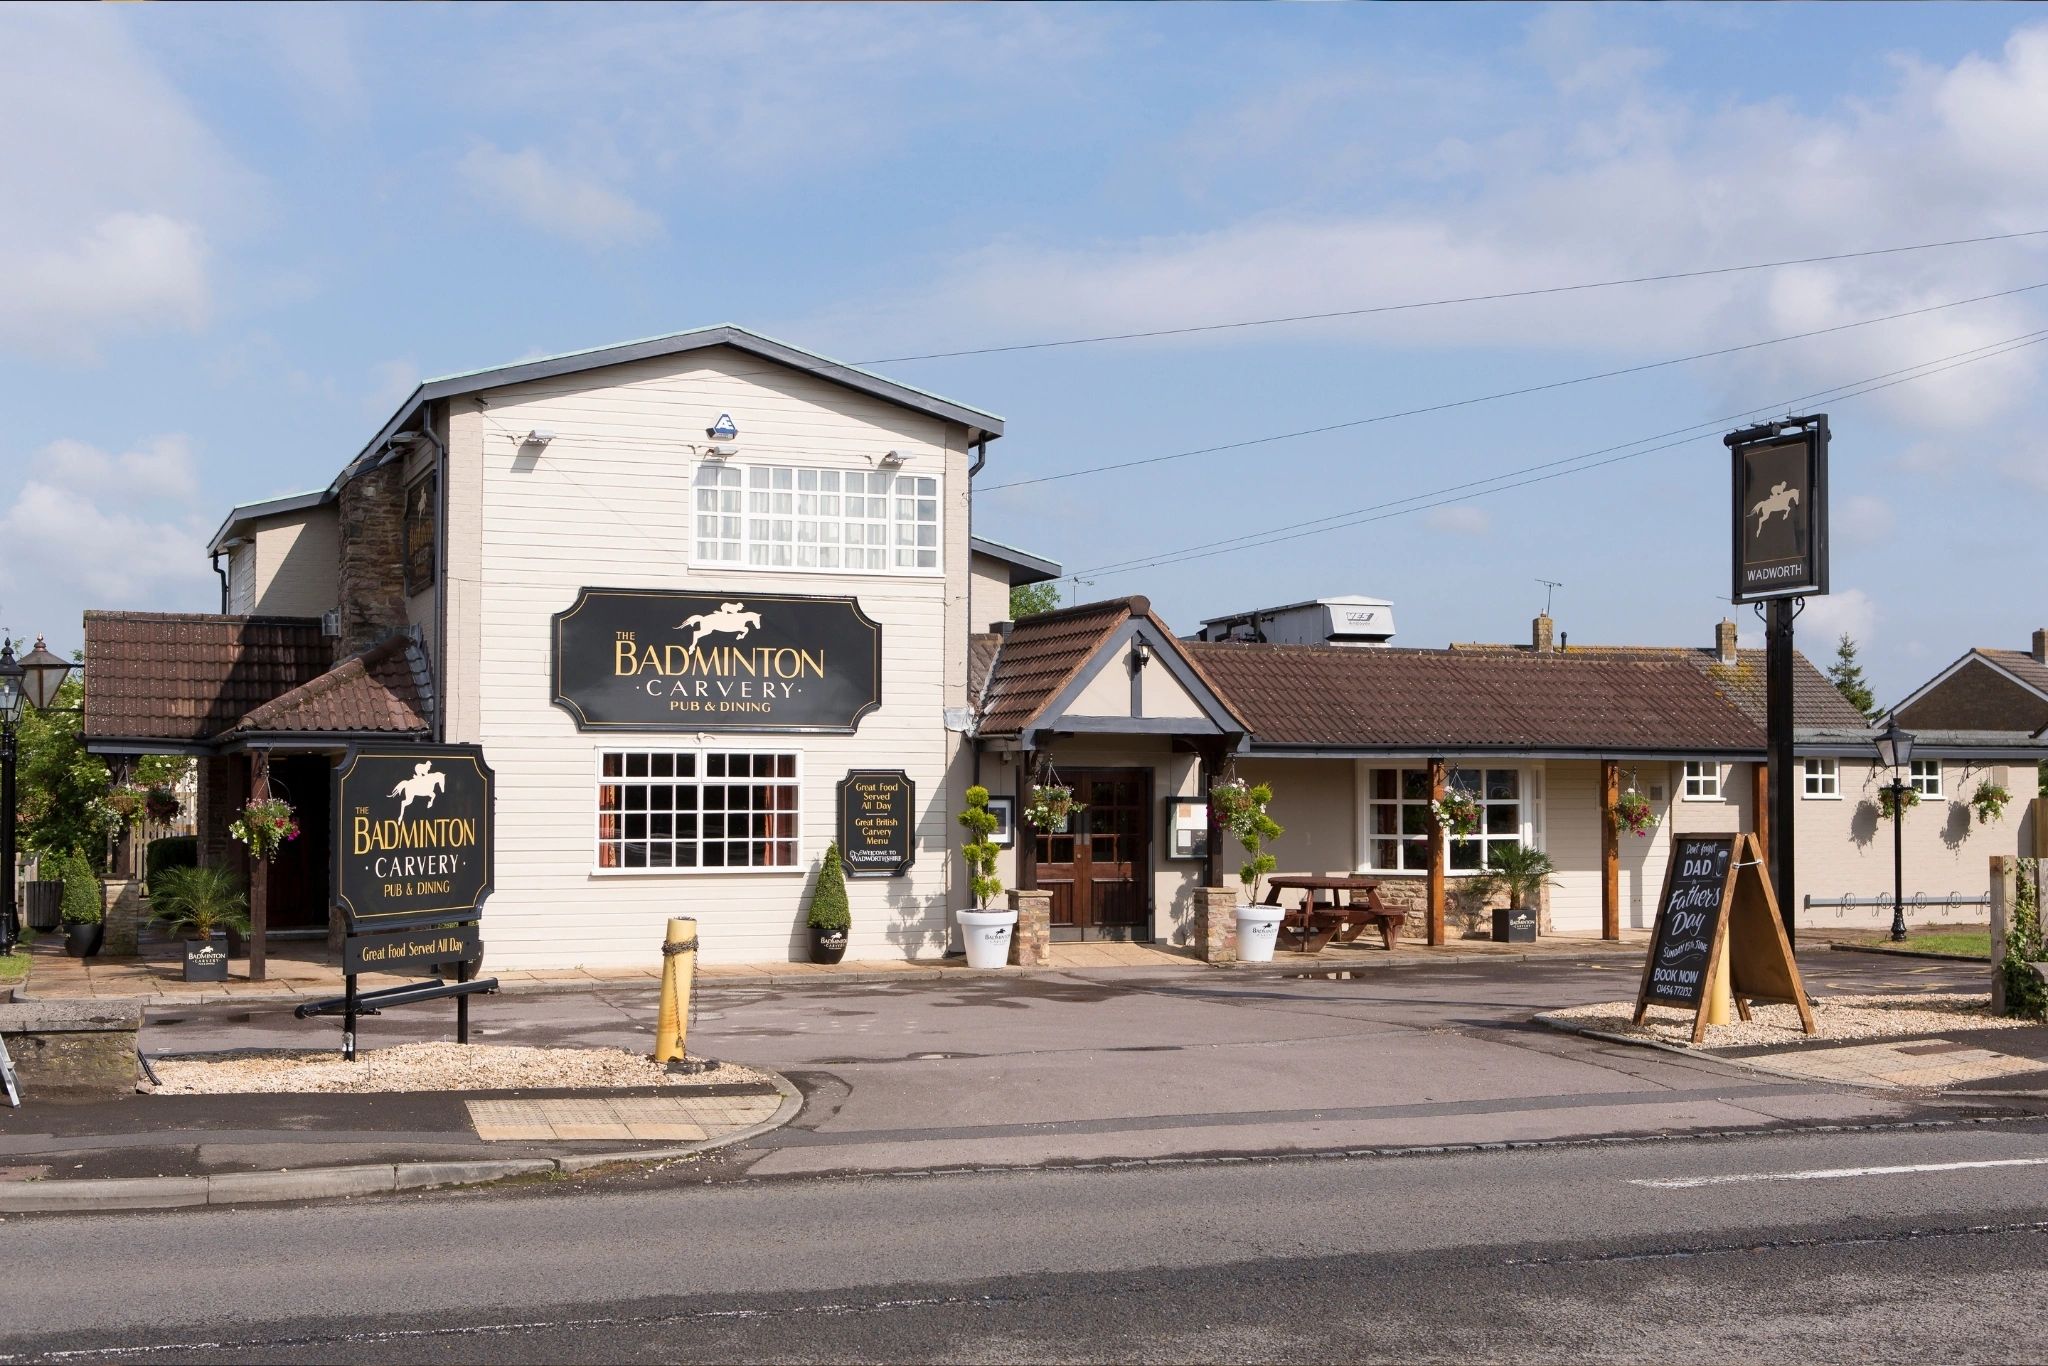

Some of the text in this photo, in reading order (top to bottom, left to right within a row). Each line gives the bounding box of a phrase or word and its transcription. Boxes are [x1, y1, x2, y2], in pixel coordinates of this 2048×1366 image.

[1747, 563, 1802, 581] WADWORTH
[616, 631, 635, 641] THE
[614, 640, 824, 679] BADMINTON
[646, 679, 795, 699] CARVERY
[670, 701, 771, 713] PUB & DINING
[855, 782, 898, 791] Great Food
[863, 792, 890, 800] Served
[355, 806, 369, 815] THE
[861, 802, 892, 811] All Day
[855, 817, 898, 826] Great British
[354, 816, 475, 855] BADMINTON
[862, 827, 892, 836] Carvery
[866, 837, 888, 845] Menu
[375, 854, 459, 878] CARVERY
[1682, 859, 1712, 877] DAD
[384, 880, 450, 897] PUB & DINING
[1667, 884, 1720, 915] Father's
[1671, 911, 1706, 937] Day
[188, 952, 226, 960] BADMINTON
[362, 937, 464, 961] Great Food Served All Day
[1663, 943, 1685, 958] SUNDAY
[1694, 940, 1708, 953] JUNE
[1653, 967, 1699, 983] BOOK NOW
